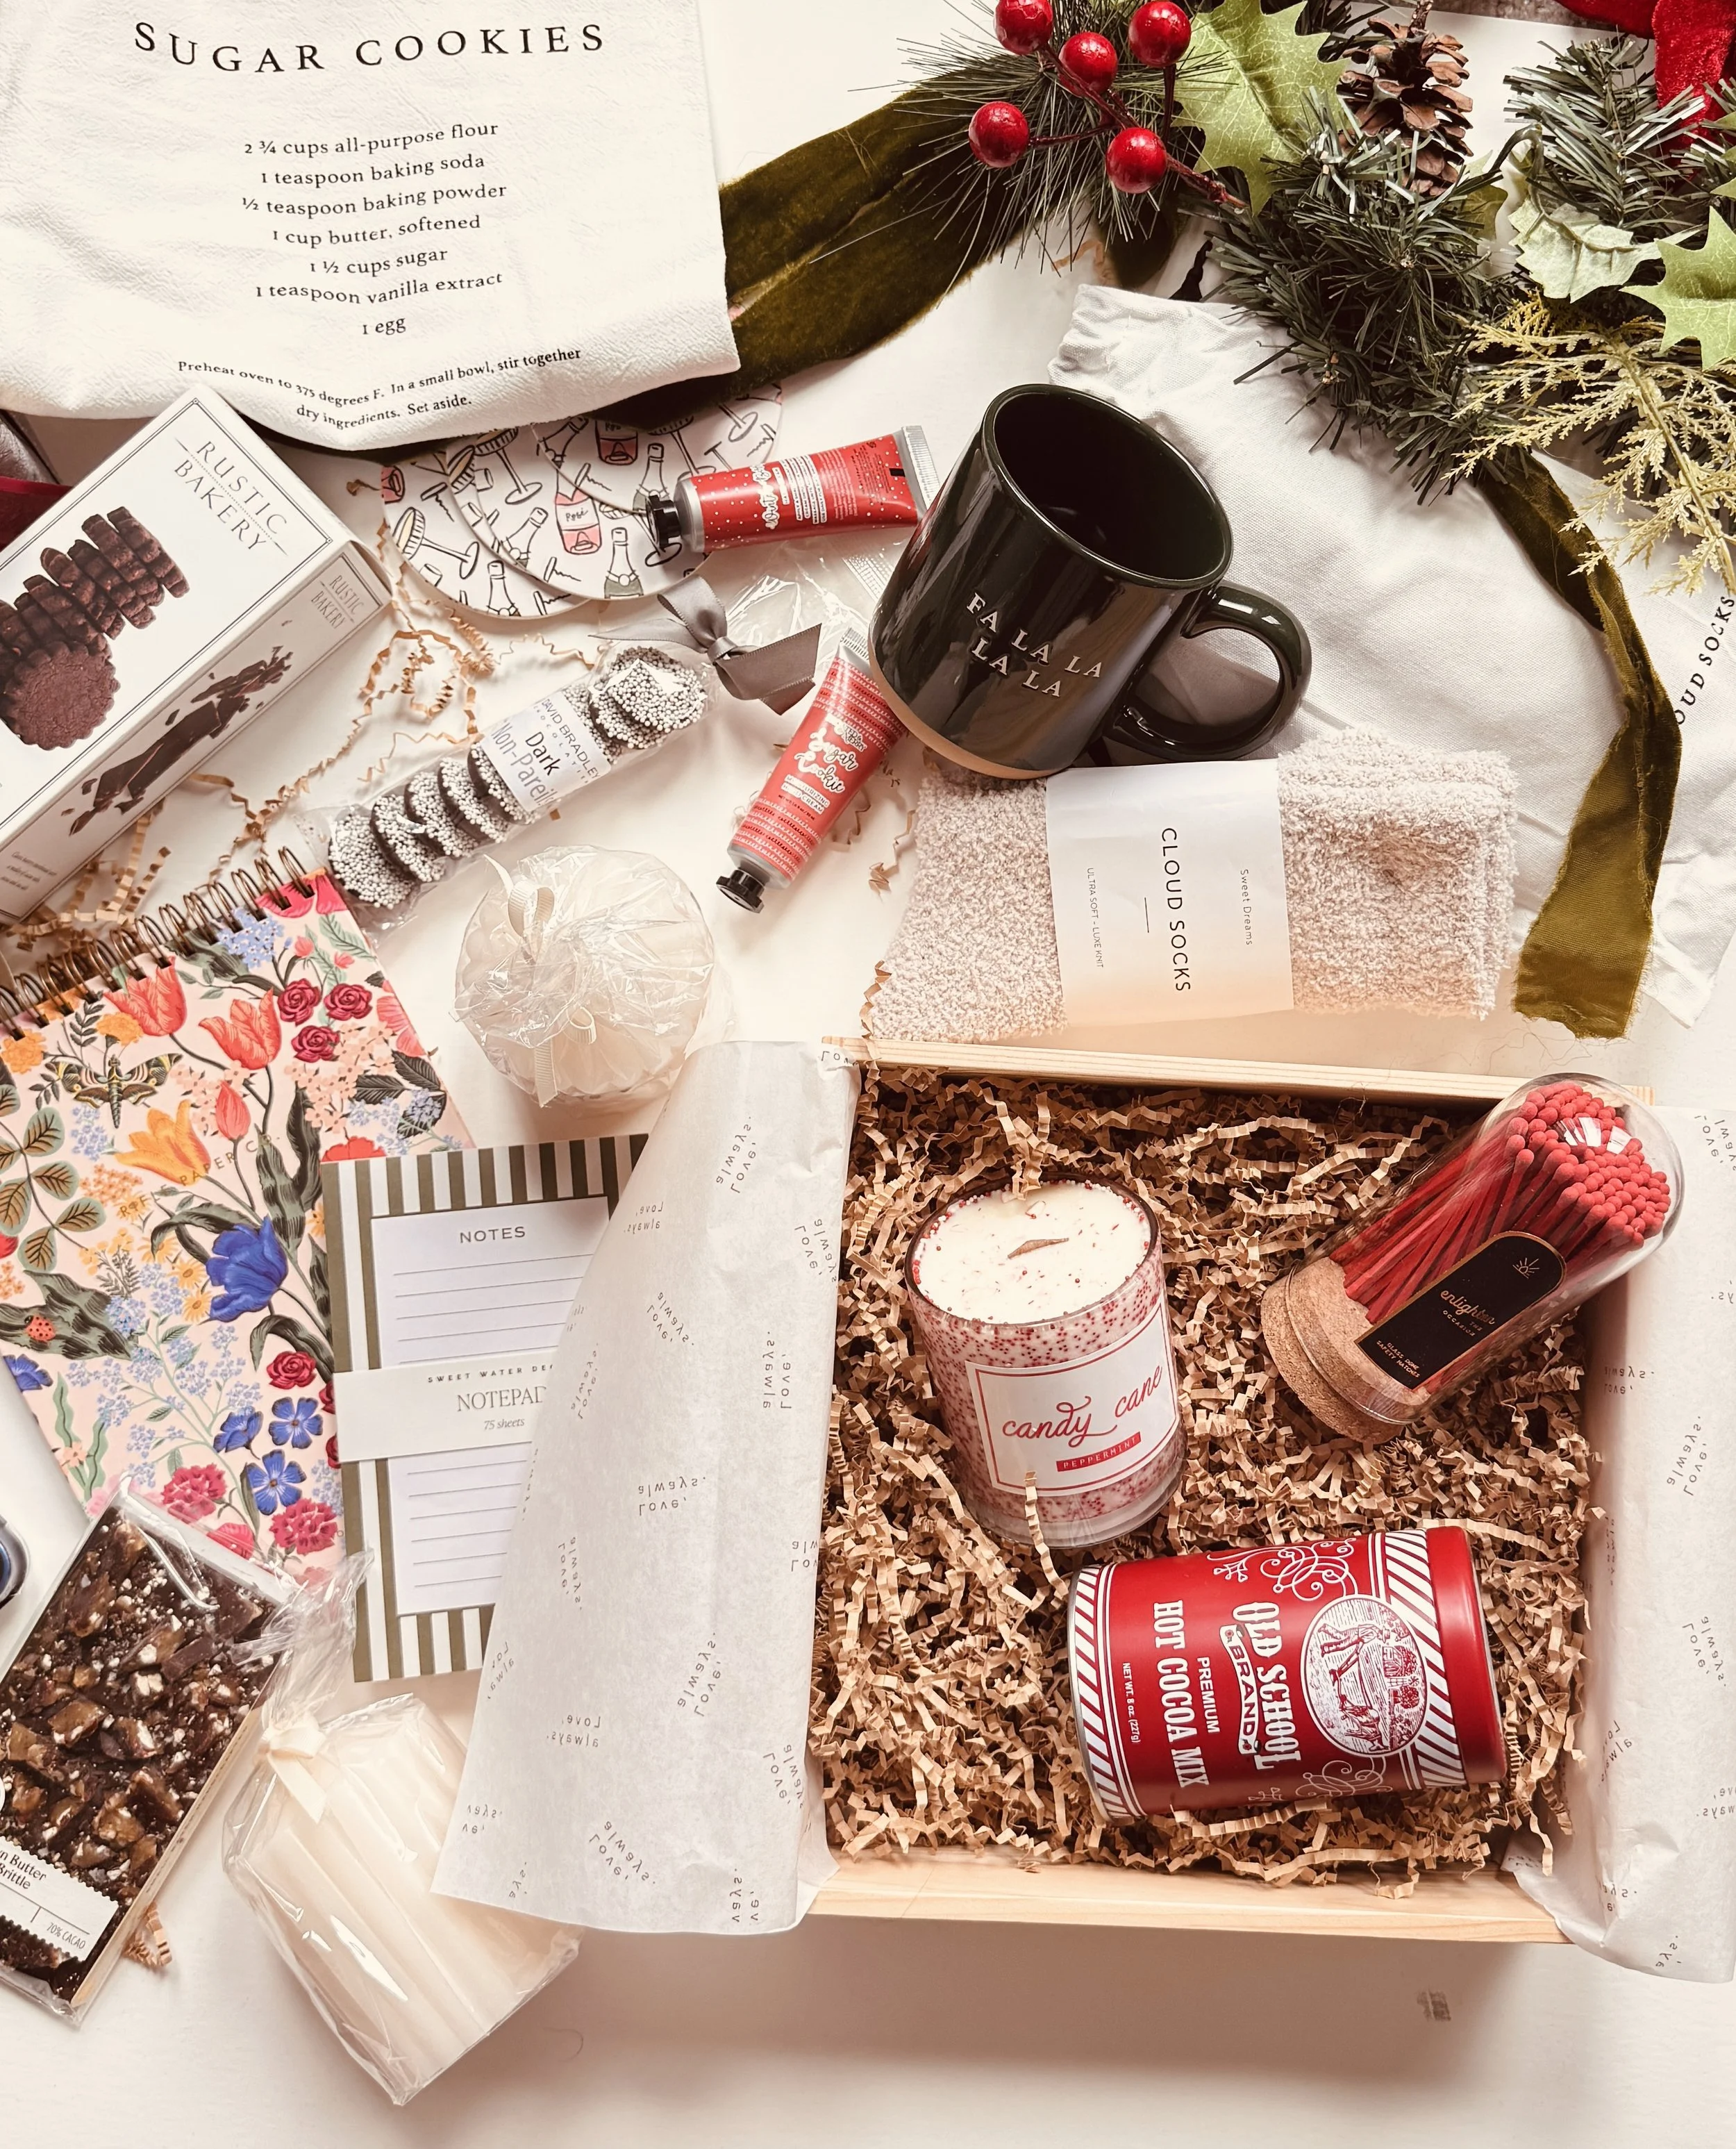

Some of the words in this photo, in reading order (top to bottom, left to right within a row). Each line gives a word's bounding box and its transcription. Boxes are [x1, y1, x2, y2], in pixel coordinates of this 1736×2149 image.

[135, 22, 325, 73] SUGAR
[356, 24, 602, 66] COOKIES
[244, 144, 252, 154] 2
[259, 140, 276, 154] ¾
[283, 144, 328, 158] cups
[335, 131, 444, 155] all-purpose
[452, 124, 499, 138] flour
[275, 172, 364, 188] teaspoon
[370, 162, 434, 181] baking
[440, 154, 485, 169] soda
[242, 197, 259, 210] ½
[267, 201, 357, 219] teaspoon
[362, 192, 426, 211] baking
[433, 183, 507, 204] powder
[285, 233, 322, 249] cup
[328, 229, 392, 244] butter,
[399, 215, 481, 235] softened
[323, 261, 339, 273] ½
[347, 260, 390, 277] cups
[397, 251, 448, 267] sugar
[269, 286, 360, 304] teaspoon
[367, 279, 429, 304] vanilla
[435, 274, 502, 290] extract
[375, 318, 406, 335] egg
[178, 361, 235, 375] Preheat
[239, 372, 274, 384] oven
[278, 379, 292, 388] to
[296, 385, 315, 397] 375
[319, 391, 369, 408] degrees
[374, 388, 385, 399] F.
[391, 384, 404, 394] In
[419, 370, 453, 387] small
[457, 361, 494, 379] bowl,
[497, 357, 519, 370] stir
[523, 348, 581, 367] together
[297, 404, 319, 422] dry
[324, 410, 400, 430] ingredients.
[408, 403, 429, 415] Set
[433, 394, 471, 410] aside.
[174, 460, 267, 549] BAKERY
[197, 441, 287, 534] RUSTIC
[311, 592, 347, 629] BAKERY
[329, 575, 365, 615] RUSTIC
[967, 592, 998, 633] FA
[1012, 629, 1050, 663] LA
[1065, 656, 1101, 678] LA
[1699, 596, 1735, 666] SOCKS
[972, 638, 1008, 675] LA
[1023, 670, 1061, 697] LA
[526, 731, 560, 776] Dark
[542, 699, 562, 724] DAVID
[559, 724, 600, 778] BRADLEY
[1087, 868, 1096, 896] ULTRA
[1162, 828, 1183, 909] CLOUD
[1241, 869, 1250, 902] Sweet
[1090, 897, 1099, 918] SOFT
[1244, 906, 1252, 945] Dreams
[1092, 927, 1101, 948] LUXE
[1169, 920, 1190, 990] SOCKS
[181, 1152, 235, 1186] PAPER
[460, 1227, 525, 1243] NOTES
[1441, 1291, 1494, 1325] enlighten
[1376, 1340, 1396, 1359] SAFETY
[1396, 1359, 1420, 1378] MATCHES
[1387, 1342, 1404, 1359] GLASS
[428, 1373, 471, 1383] SWEET
[481, 1368, 522, 1377] WATER
[484, 1420, 495, 1431] 75
[497, 1418, 525, 1429] sheets
[1003, 1396, 1117, 1447] candy
[1115, 1366, 1162, 1418] cane
[1063, 1438, 1138, 1468] PEPPERMINT
[1153, 1600, 1185, 1650] HOT
[1233, 1602, 1282, 1659] OLD
[1123, 1662, 1132, 1680] NET
[1125, 1682, 1133, 1696] WT.
[1157, 1659, 1197, 1743] COCOA
[1197, 1657, 1221, 1734] PREMIUM
[1230, 1643, 1258, 1736] BRAND
[1128, 1706, 1135, 1718] oz
[1254, 1664, 1301, 1770] SCHOOL
[1128, 1719, 1141, 1743] (227g)
[1172, 1745, 1209, 1789] MIX
[0, 1863, 31, 1889] Brittle
[10, 1854, 47, 1881] Butter
[47, 1923, 62, 1936] 70%
[62, 1932, 86, 1949] CACAO
